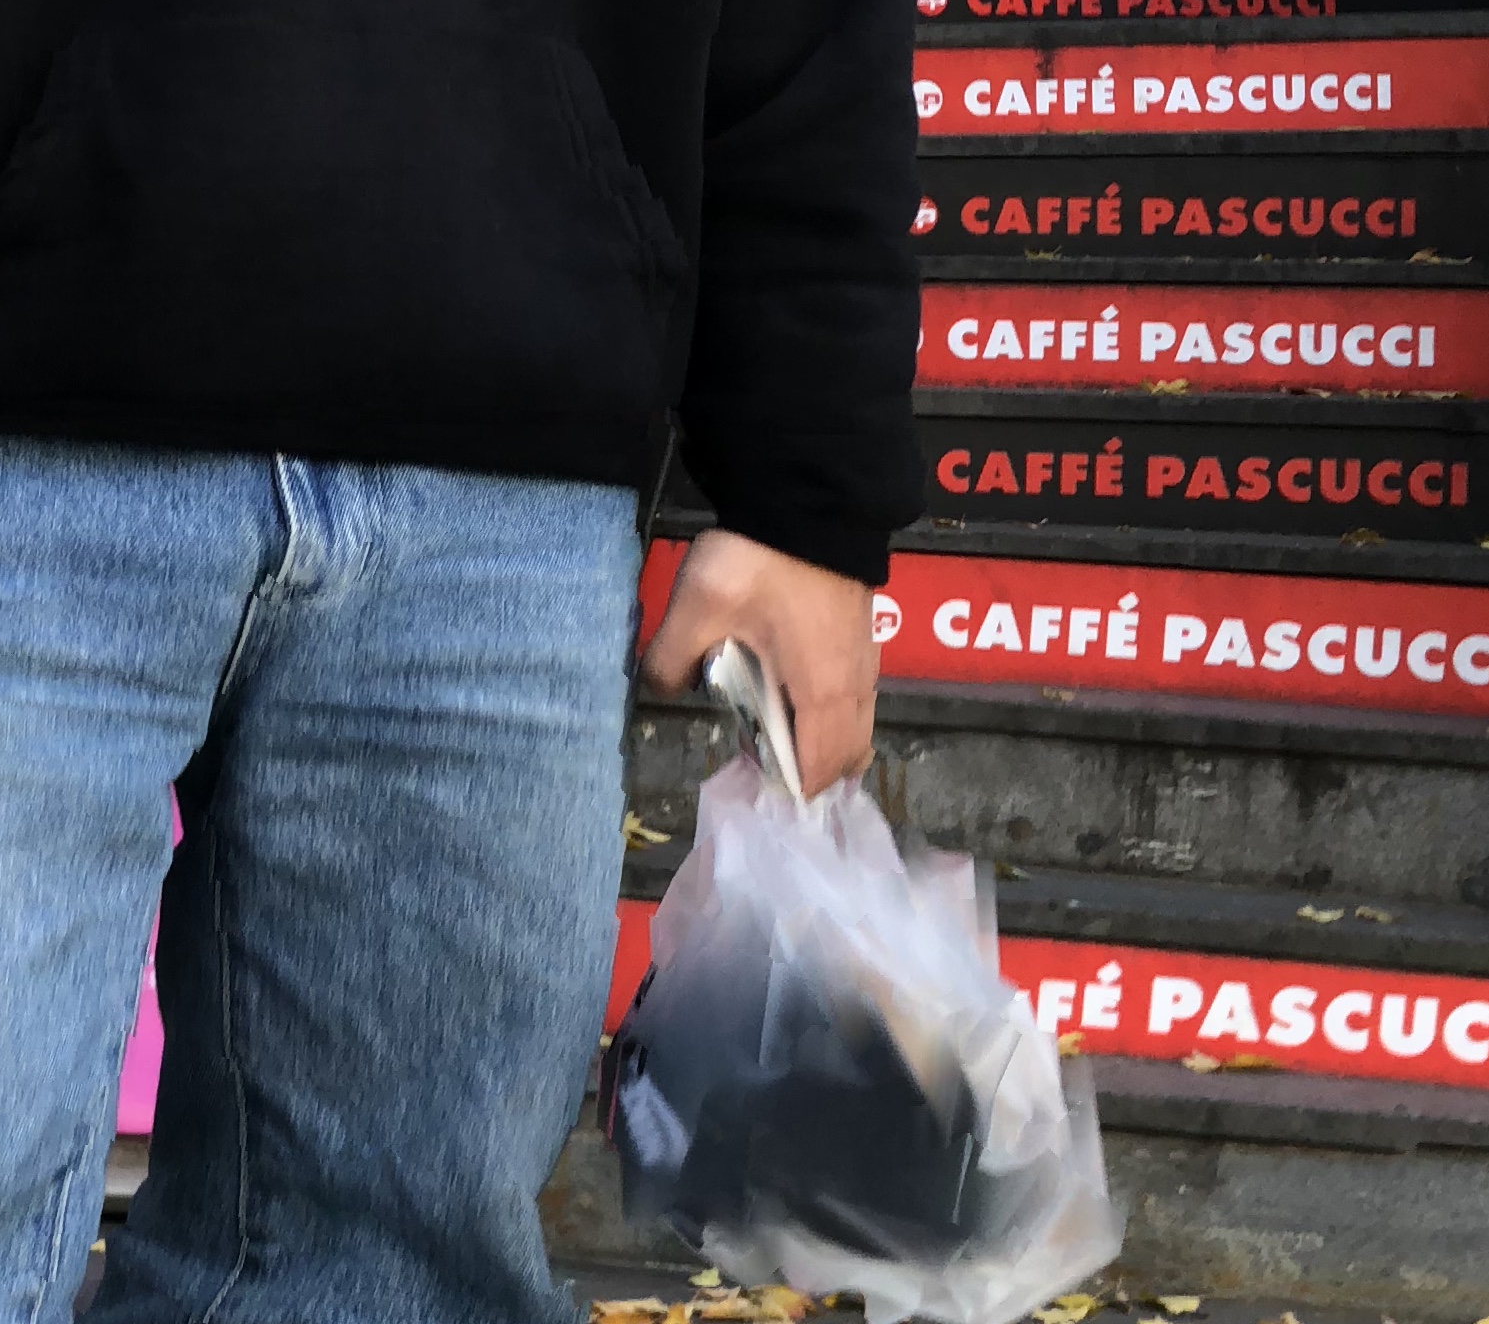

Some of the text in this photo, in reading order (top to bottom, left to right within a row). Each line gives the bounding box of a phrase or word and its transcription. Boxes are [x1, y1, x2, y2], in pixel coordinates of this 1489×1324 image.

[962, 63, 1392, 117] CAFFÉ PASCUCCI
[960, 183, 1417, 239] CAFFÉ PASCUCCI
[947, 304, 1436, 368] CAFFÉ PASCUCCI
[936, 436, 1470, 507] CAFFÉ PASCUCCI
[932, 590, 1489, 686] CAFFÉ PASCUCC
[1147, 974, 1489, 1065] PASCUC
